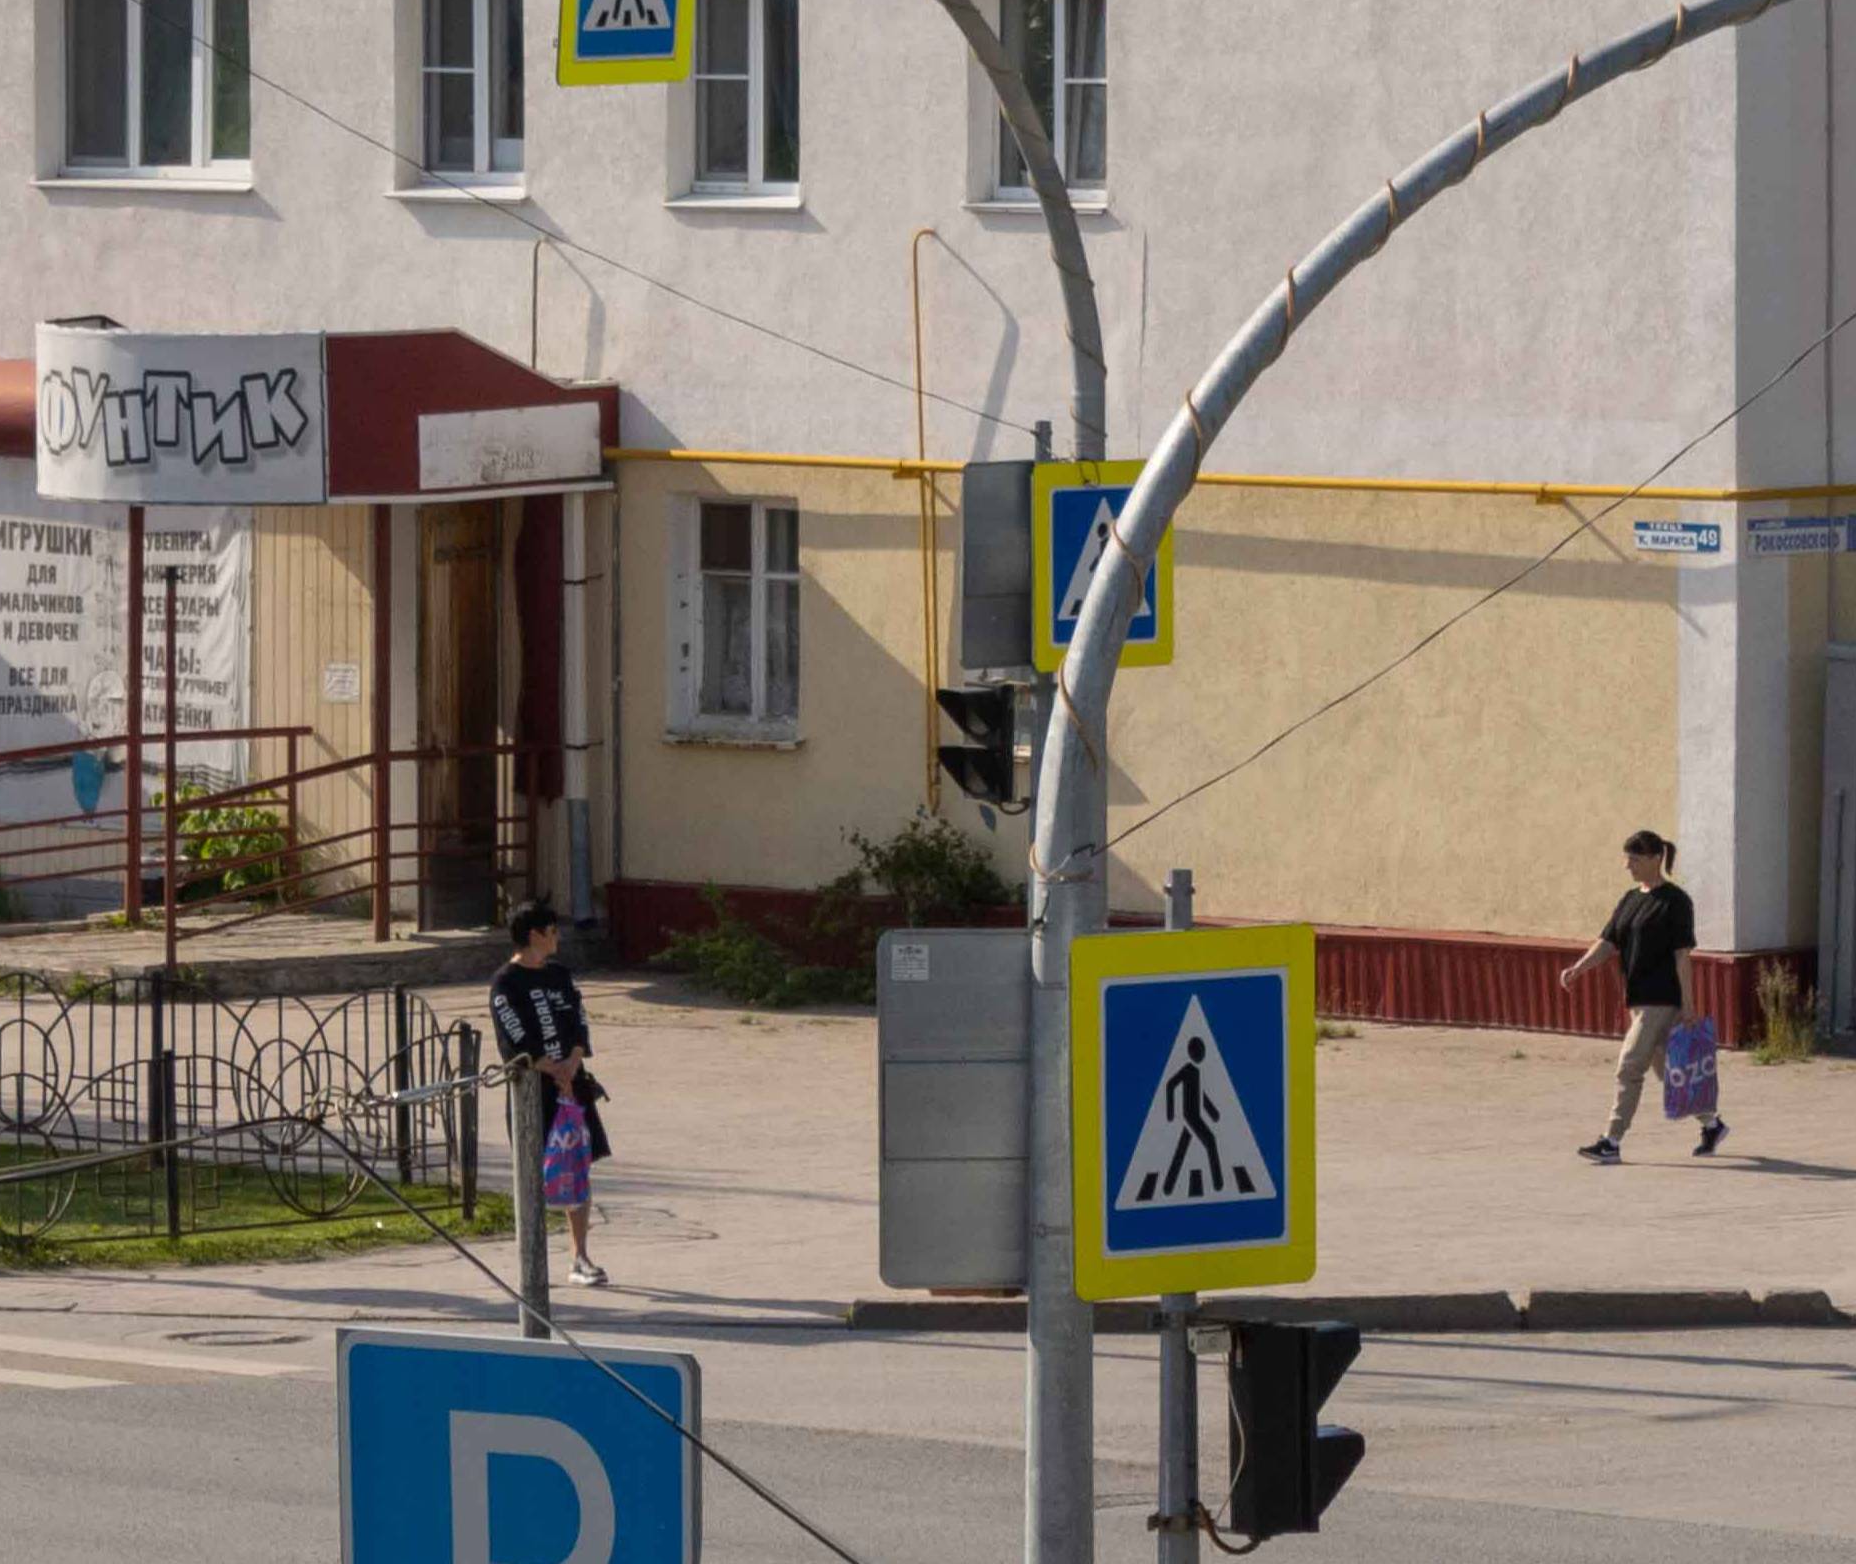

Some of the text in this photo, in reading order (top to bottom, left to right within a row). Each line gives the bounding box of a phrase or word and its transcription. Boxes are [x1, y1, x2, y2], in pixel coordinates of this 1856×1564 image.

[43, 367, 308, 466] ФУНТИК
[144, 531, 211, 552] УВЕНИРЫ
[1651, 535, 1695, 546] МАРКСА
[1698, 528, 1718, 547] 49
[27, 565, 57, 586] ДЛЯ
[0, 592, 84, 615] МАЛЬЧИКОВ
[3, 620, 79, 643] И ДЕВОЧЕК
[144, 645, 202, 675] ЧАЫ:
[9, 666, 68, 688] ВСЕ ДЛЯ
[494, 994, 526, 1044] WORLD
[530, 989, 557, 1041] WORLD
